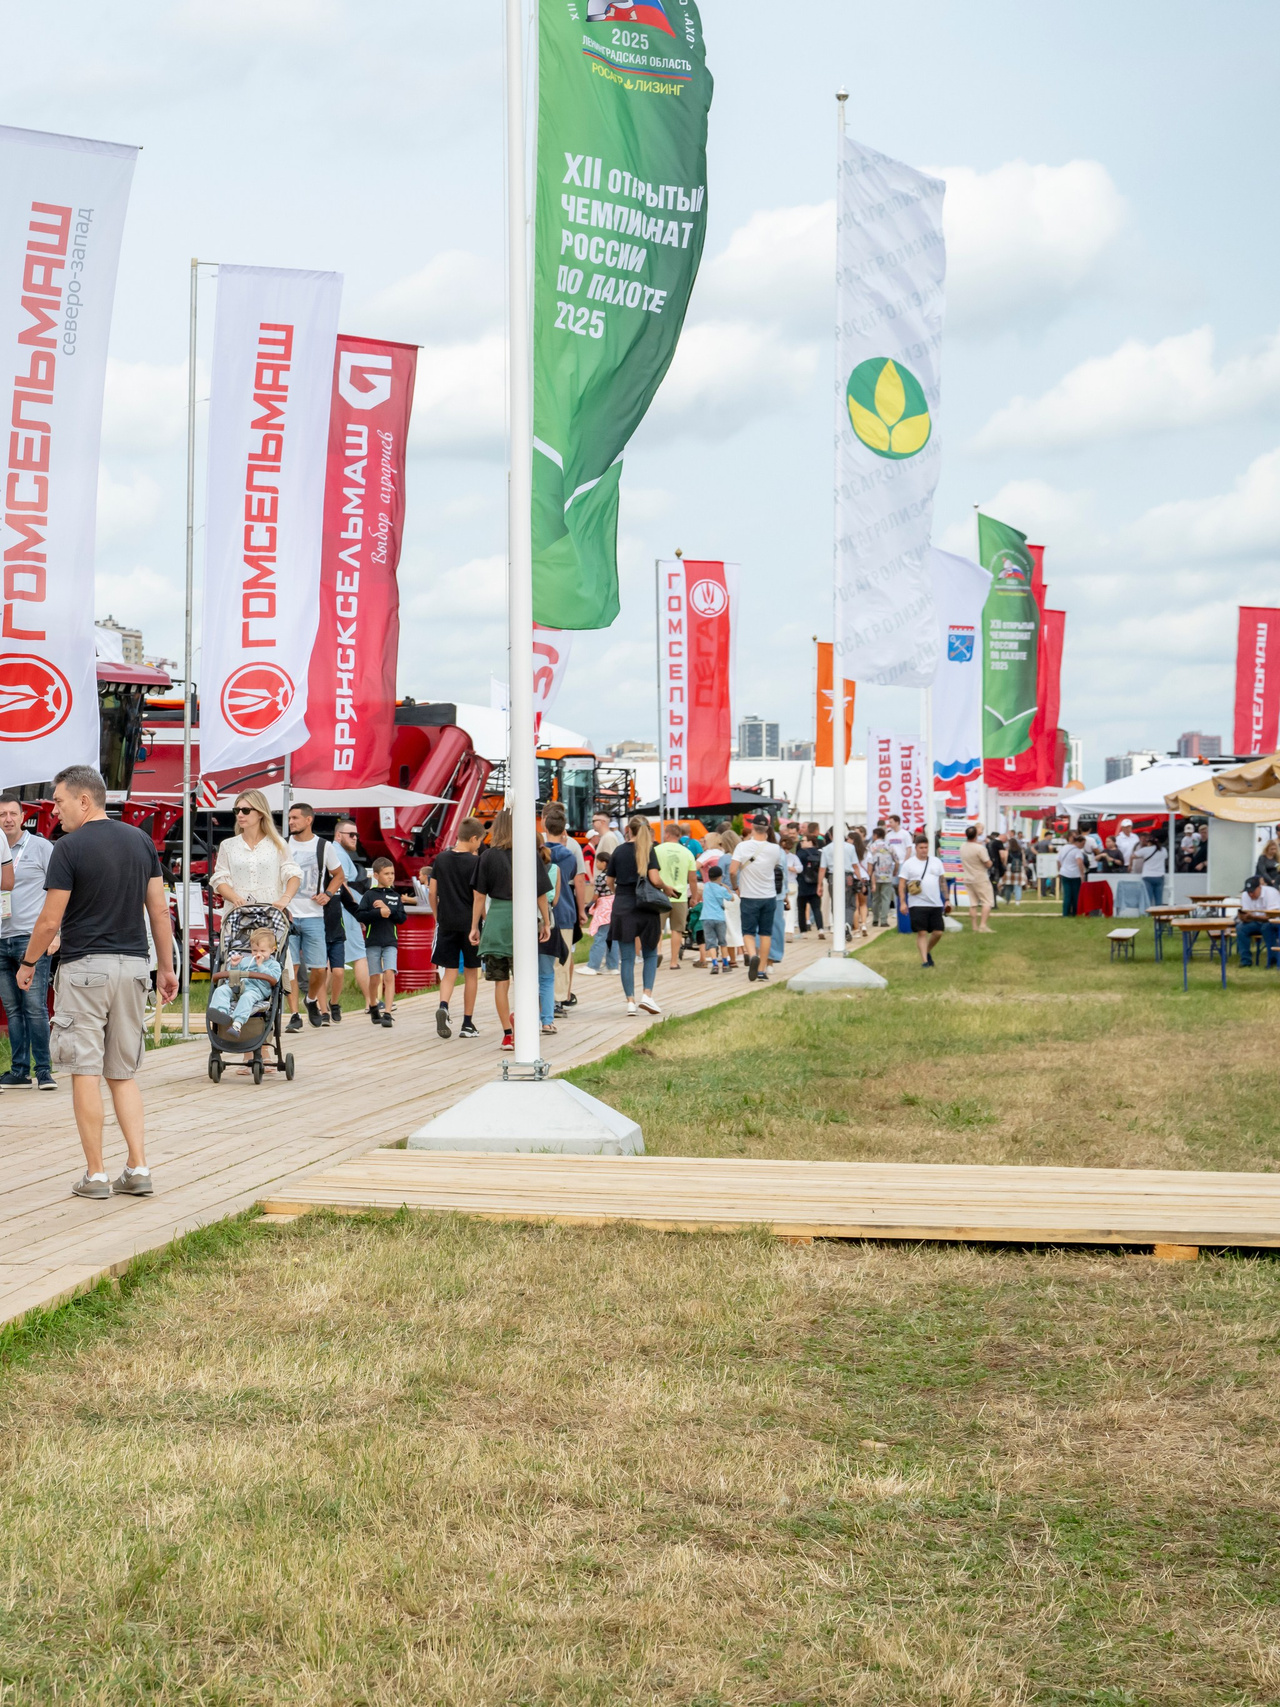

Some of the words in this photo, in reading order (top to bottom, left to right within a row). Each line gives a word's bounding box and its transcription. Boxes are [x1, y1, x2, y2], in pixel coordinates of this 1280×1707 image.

[582, 35, 647, 66] ЛЕНИНГРАДСКАЯ
[649, 56, 692, 72] ОБЛАСТЬ
[611, 28, 650, 50] 2025
[562, 152, 603, 190] XII
[608, 168, 705, 213] ОТКРЫТЫЙ
[560, 228, 647, 273] РОССИИ
[561, 193, 694, 249] ЧЕМПИОНАТ
[62, 207, 94, 357] северо-запад
[556, 265, 584, 295] ПО
[586, 273, 668, 314] ПАХОТЕ
[554, 301, 606, 339] 2025
[3, 201, 72, 641] ГОМСЕЛЬМАШ
[242, 322, 294, 649] ГОМСЕЛЬМАШ
[378, 430, 395, 504] аграриев
[371, 510, 392, 566] Выбор
[333, 424, 369, 771] БРЯНСКСЕЛЬМАШ
[667, 573, 683, 793] ГОМСЕЛЬМАШ
[1251, 623, 1268, 755] СТСЕЛЬМАШ
[878, 738, 892, 826] ИРОВЕЦ
